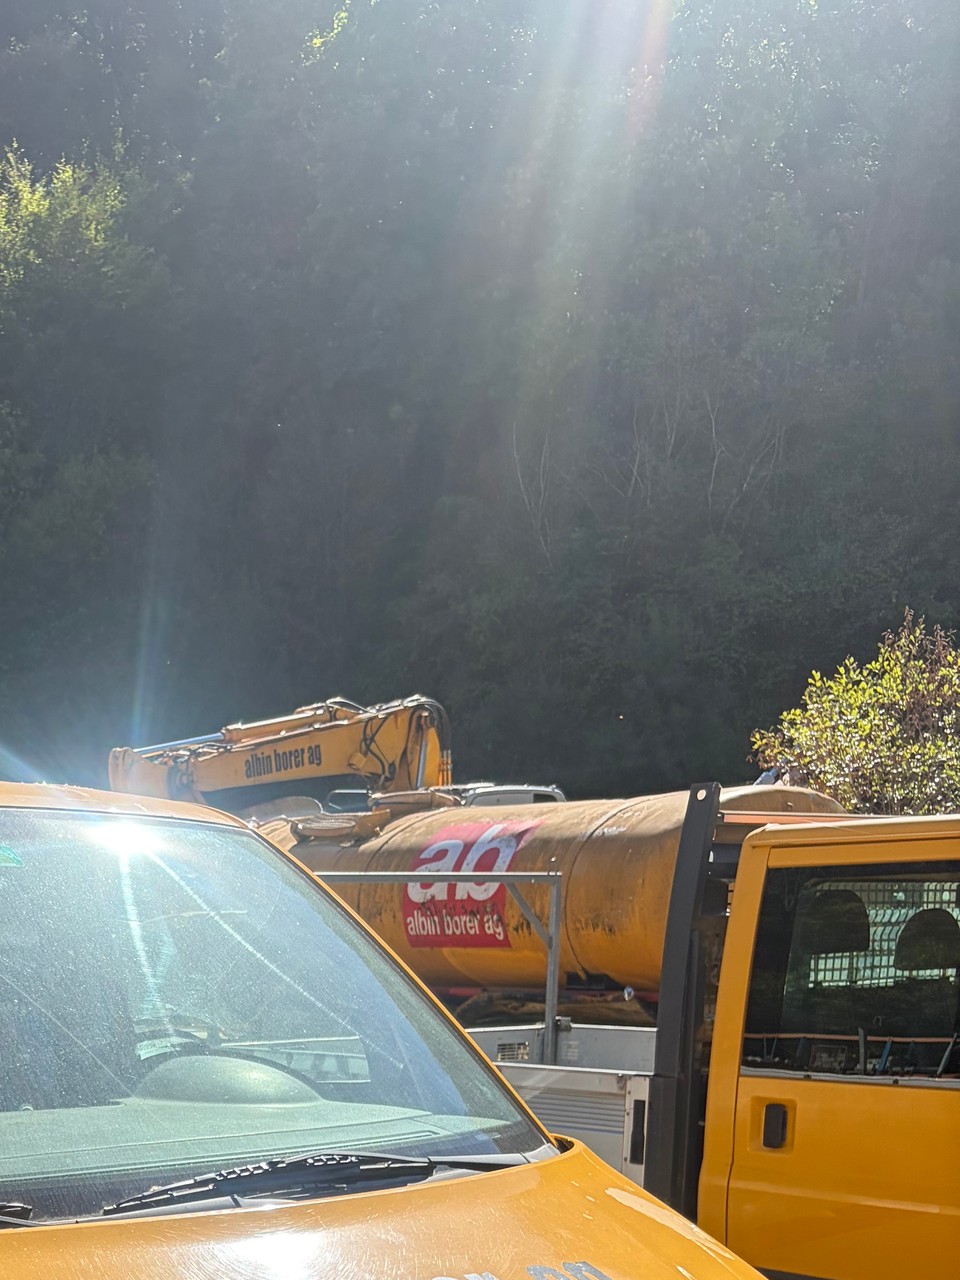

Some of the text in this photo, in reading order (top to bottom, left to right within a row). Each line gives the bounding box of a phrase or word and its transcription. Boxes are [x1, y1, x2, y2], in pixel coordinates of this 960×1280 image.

[245, 744, 322, 779] albin borer ag
[407, 823, 517, 903] ab
[406, 909, 504, 940] albin borer ag
